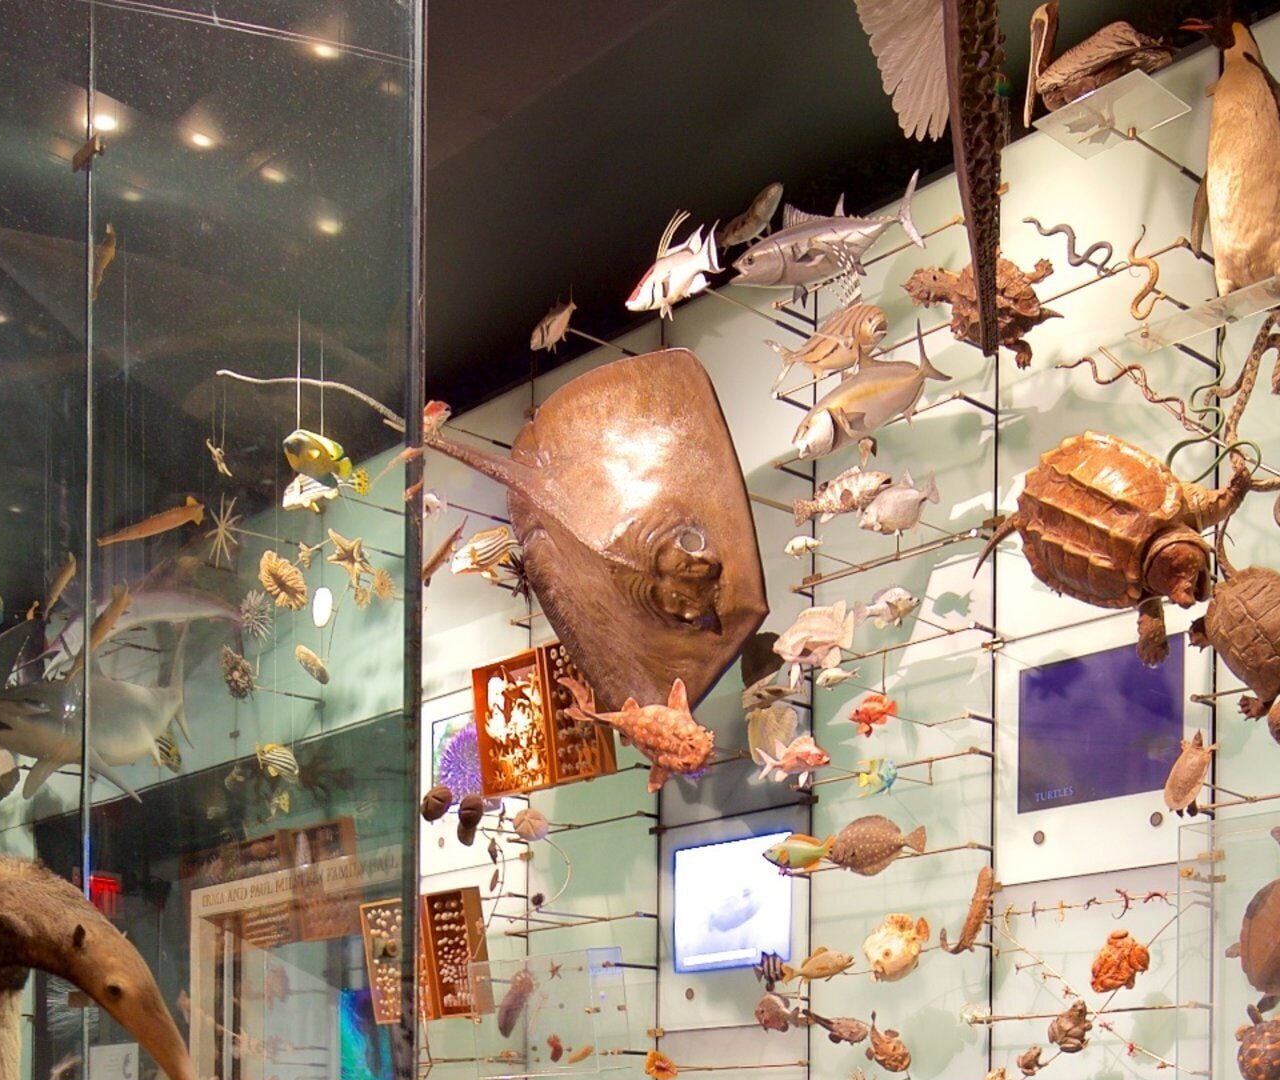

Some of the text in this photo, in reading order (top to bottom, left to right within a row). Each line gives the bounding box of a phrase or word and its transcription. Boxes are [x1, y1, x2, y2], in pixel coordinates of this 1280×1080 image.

[1035, 786, 1073, 802] TURTLES
[228, 887, 247, 902] AND
[250, 882, 272, 898] PAUL
